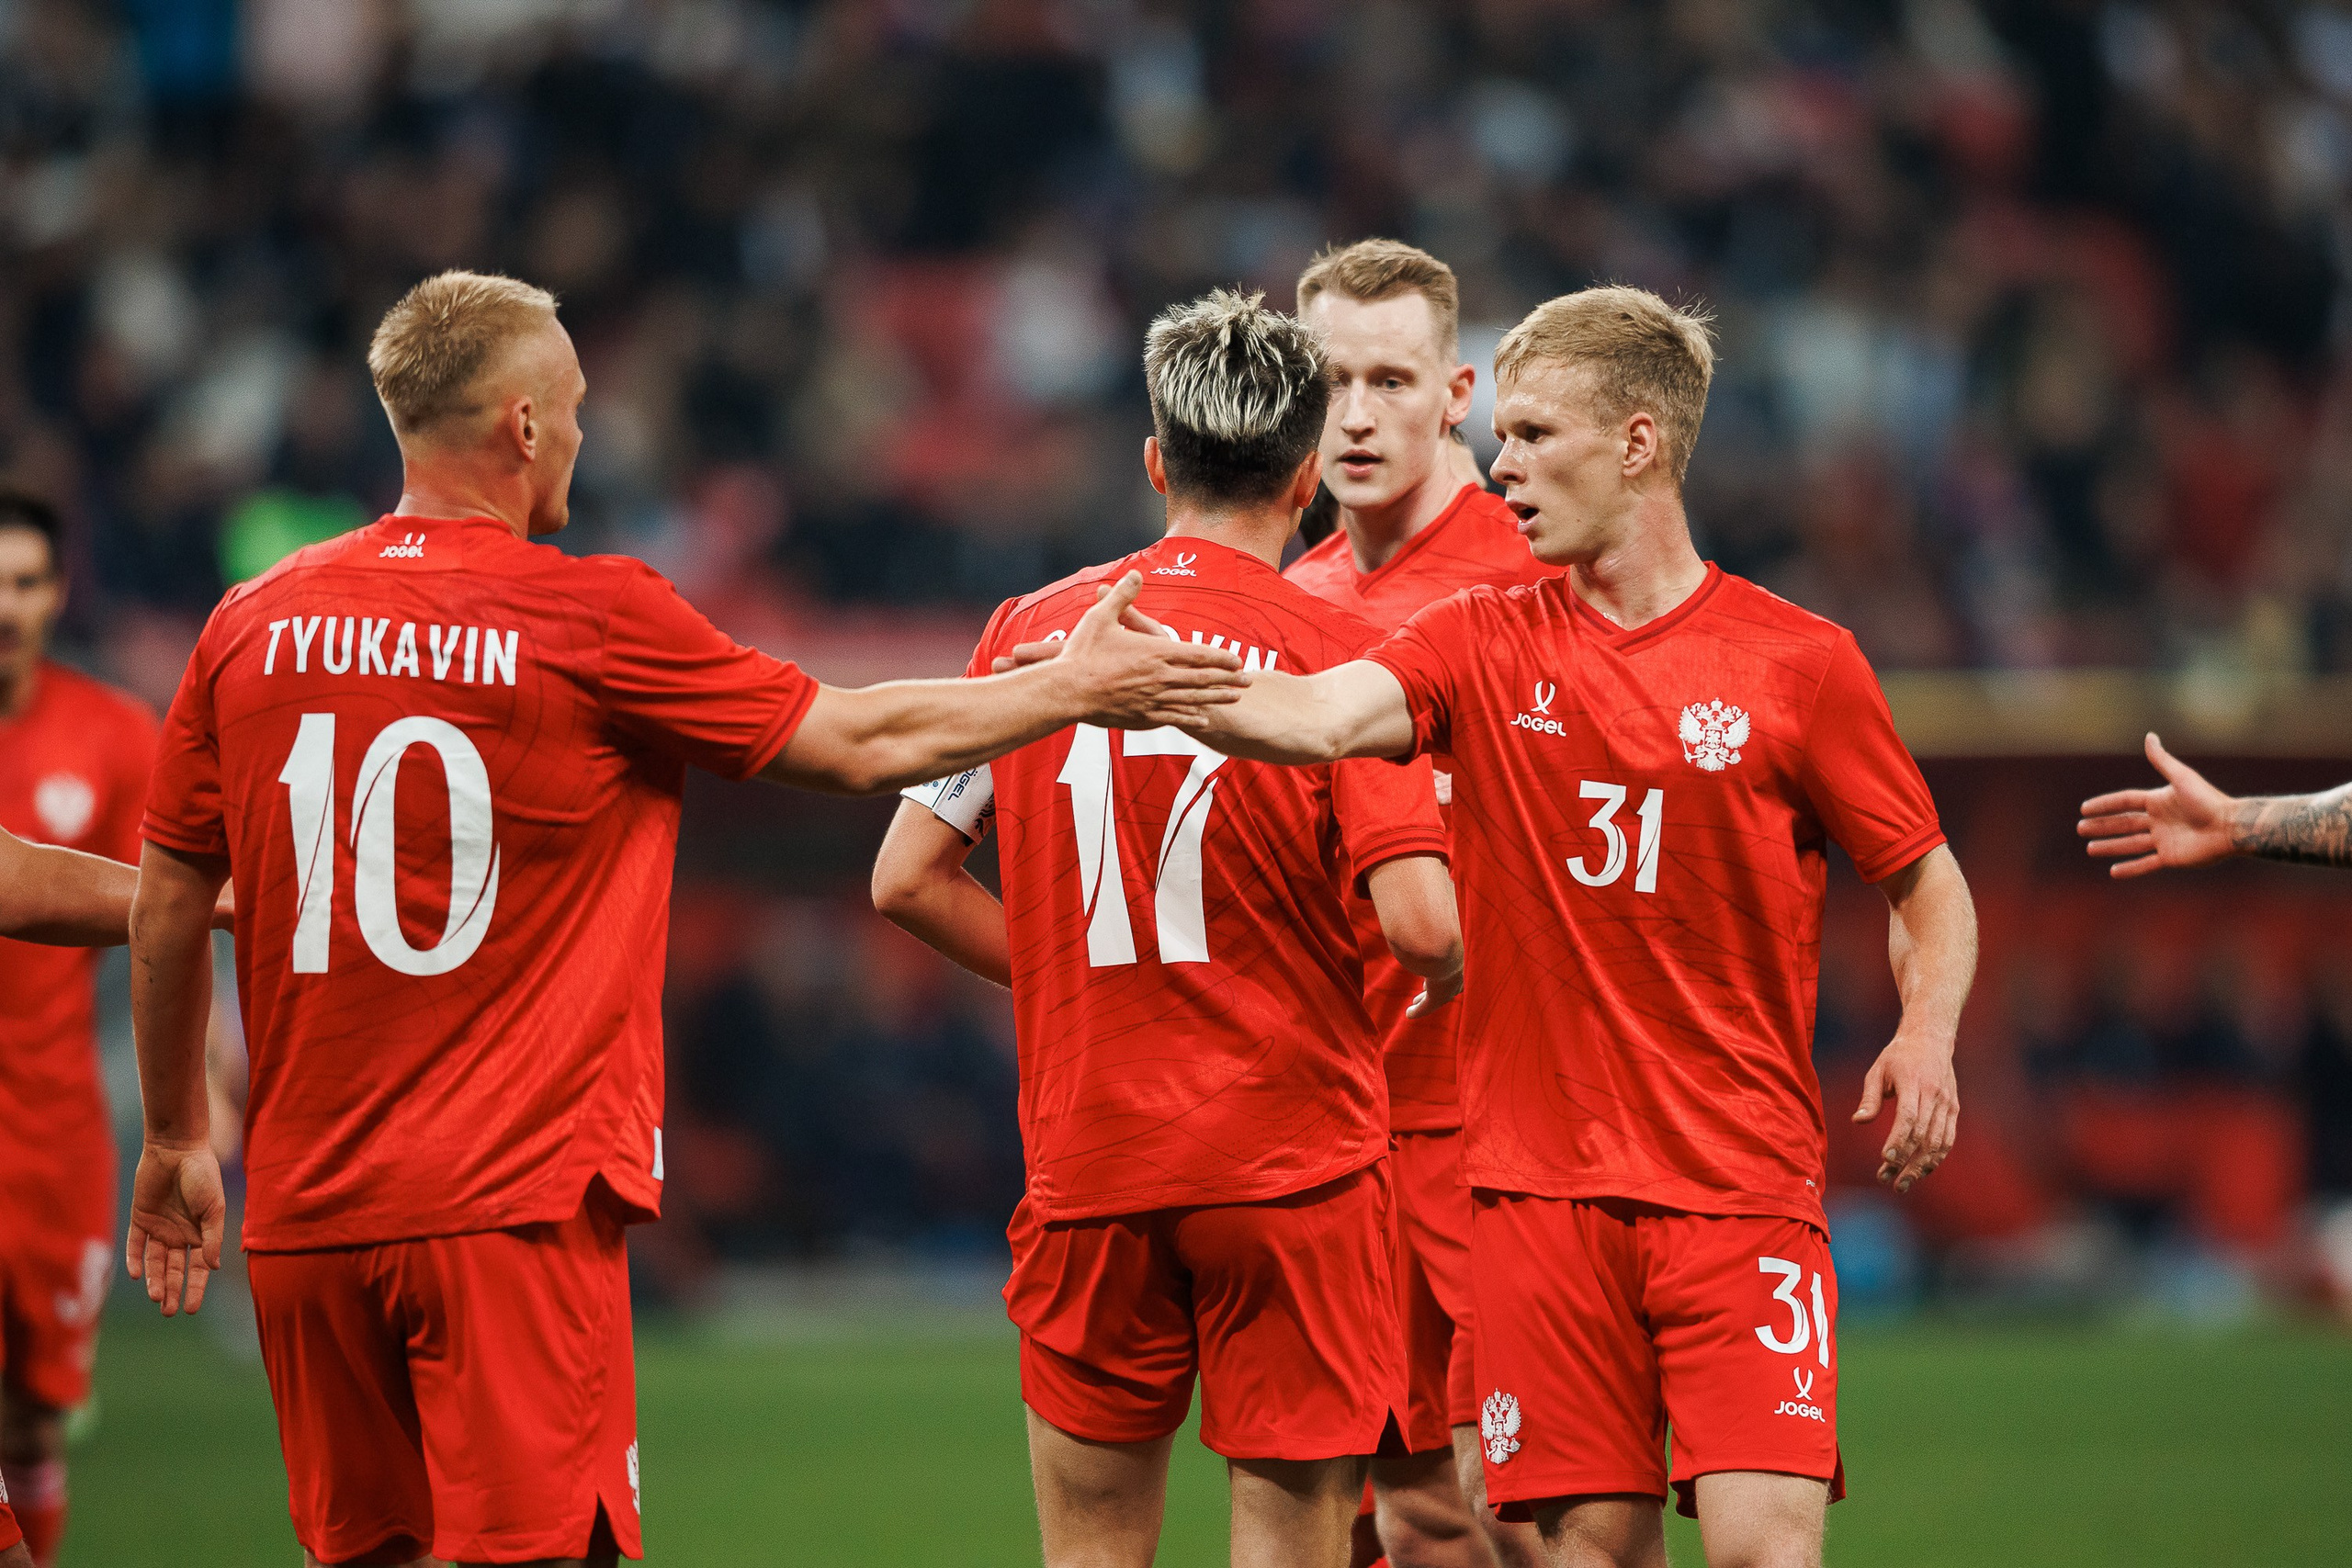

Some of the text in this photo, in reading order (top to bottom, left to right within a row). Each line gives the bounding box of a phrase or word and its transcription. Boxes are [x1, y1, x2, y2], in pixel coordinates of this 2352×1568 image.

[1150, 567, 1197, 577] JOGEL
[264, 615, 520, 686] TYUKAVIN
[1510, 712, 1567, 737] JOGEL
[947, 767, 978, 801] ÖGEL
[277, 713, 501, 976] 10
[1056, 722, 1229, 968] 17
[1566, 779, 1664, 893] 31
[1754, 1256, 1829, 1370] 31
[1774, 1400, 1826, 1423] JOGEL
